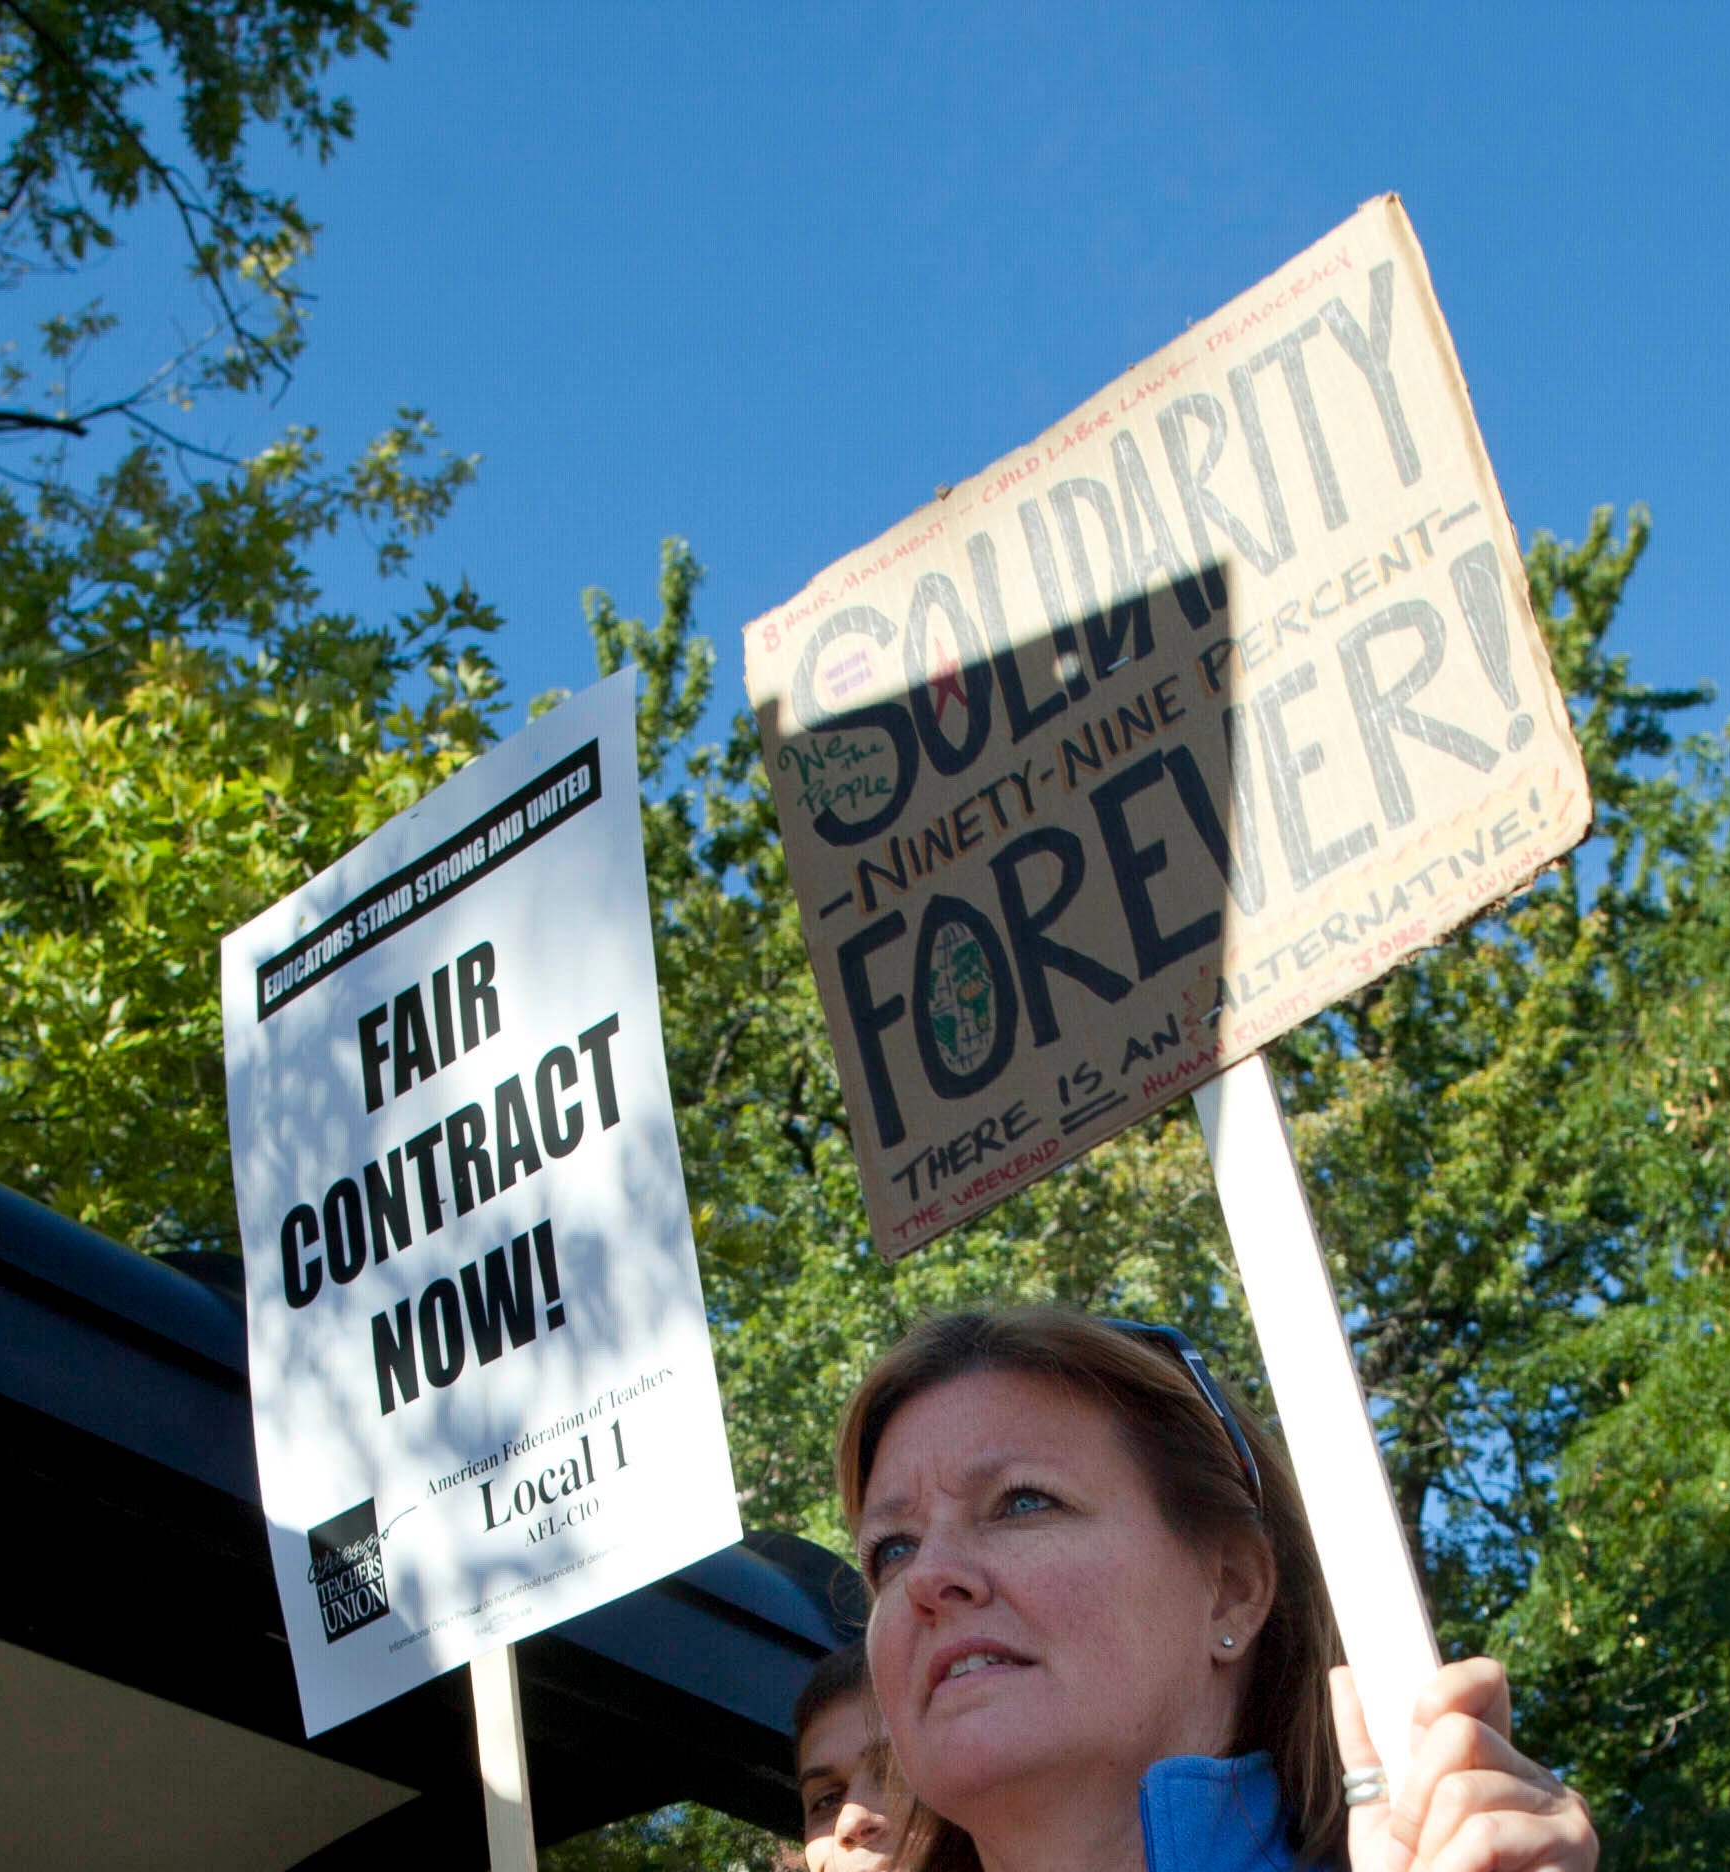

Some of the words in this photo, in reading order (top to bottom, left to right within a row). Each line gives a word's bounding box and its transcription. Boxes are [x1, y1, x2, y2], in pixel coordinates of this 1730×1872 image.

[1206, 246, 1353, 353] DEMOCRACY
[790, 259, 1423, 849] SOLIDARITY
[263, 920, 354, 1005] EDUCATORS
[357, 884, 414, 940] STAND
[416, 841, 486, 902] STRONG
[489, 820, 525, 861] AND
[527, 764, 591, 835] UNITED
[837, 542, 1535, 1150] FOREVER!
[358, 940, 502, 1115] FAIR
[892, 1101, 1042, 1201] THERE
[1058, 1060, 1105, 1106] IS
[1119, 1015, 1180, 1077] AN
[1204, 788, 1549, 1028] ALTERNATIVE!
[280, 1011, 621, 1310] CONTRACT
[893, 1203, 946, 1239] THE
[1141, 1038, 1226, 1099] HUMAN
[371, 1218, 566, 1417] NOW!
[426, 1451, 499, 1499] American
[503, 1411, 586, 1463] Federation
[589, 1396, 604, 1419] of
[606, 1367, 674, 1409] Teachers
[477, 1434, 597, 1533] Local
[610, 1419, 630, 1471] 1
[525, 1497, 600, 1547] AFL-CIO
[318, 1554, 384, 1605] TEACHERS
[322, 1578, 388, 1634] UNION
